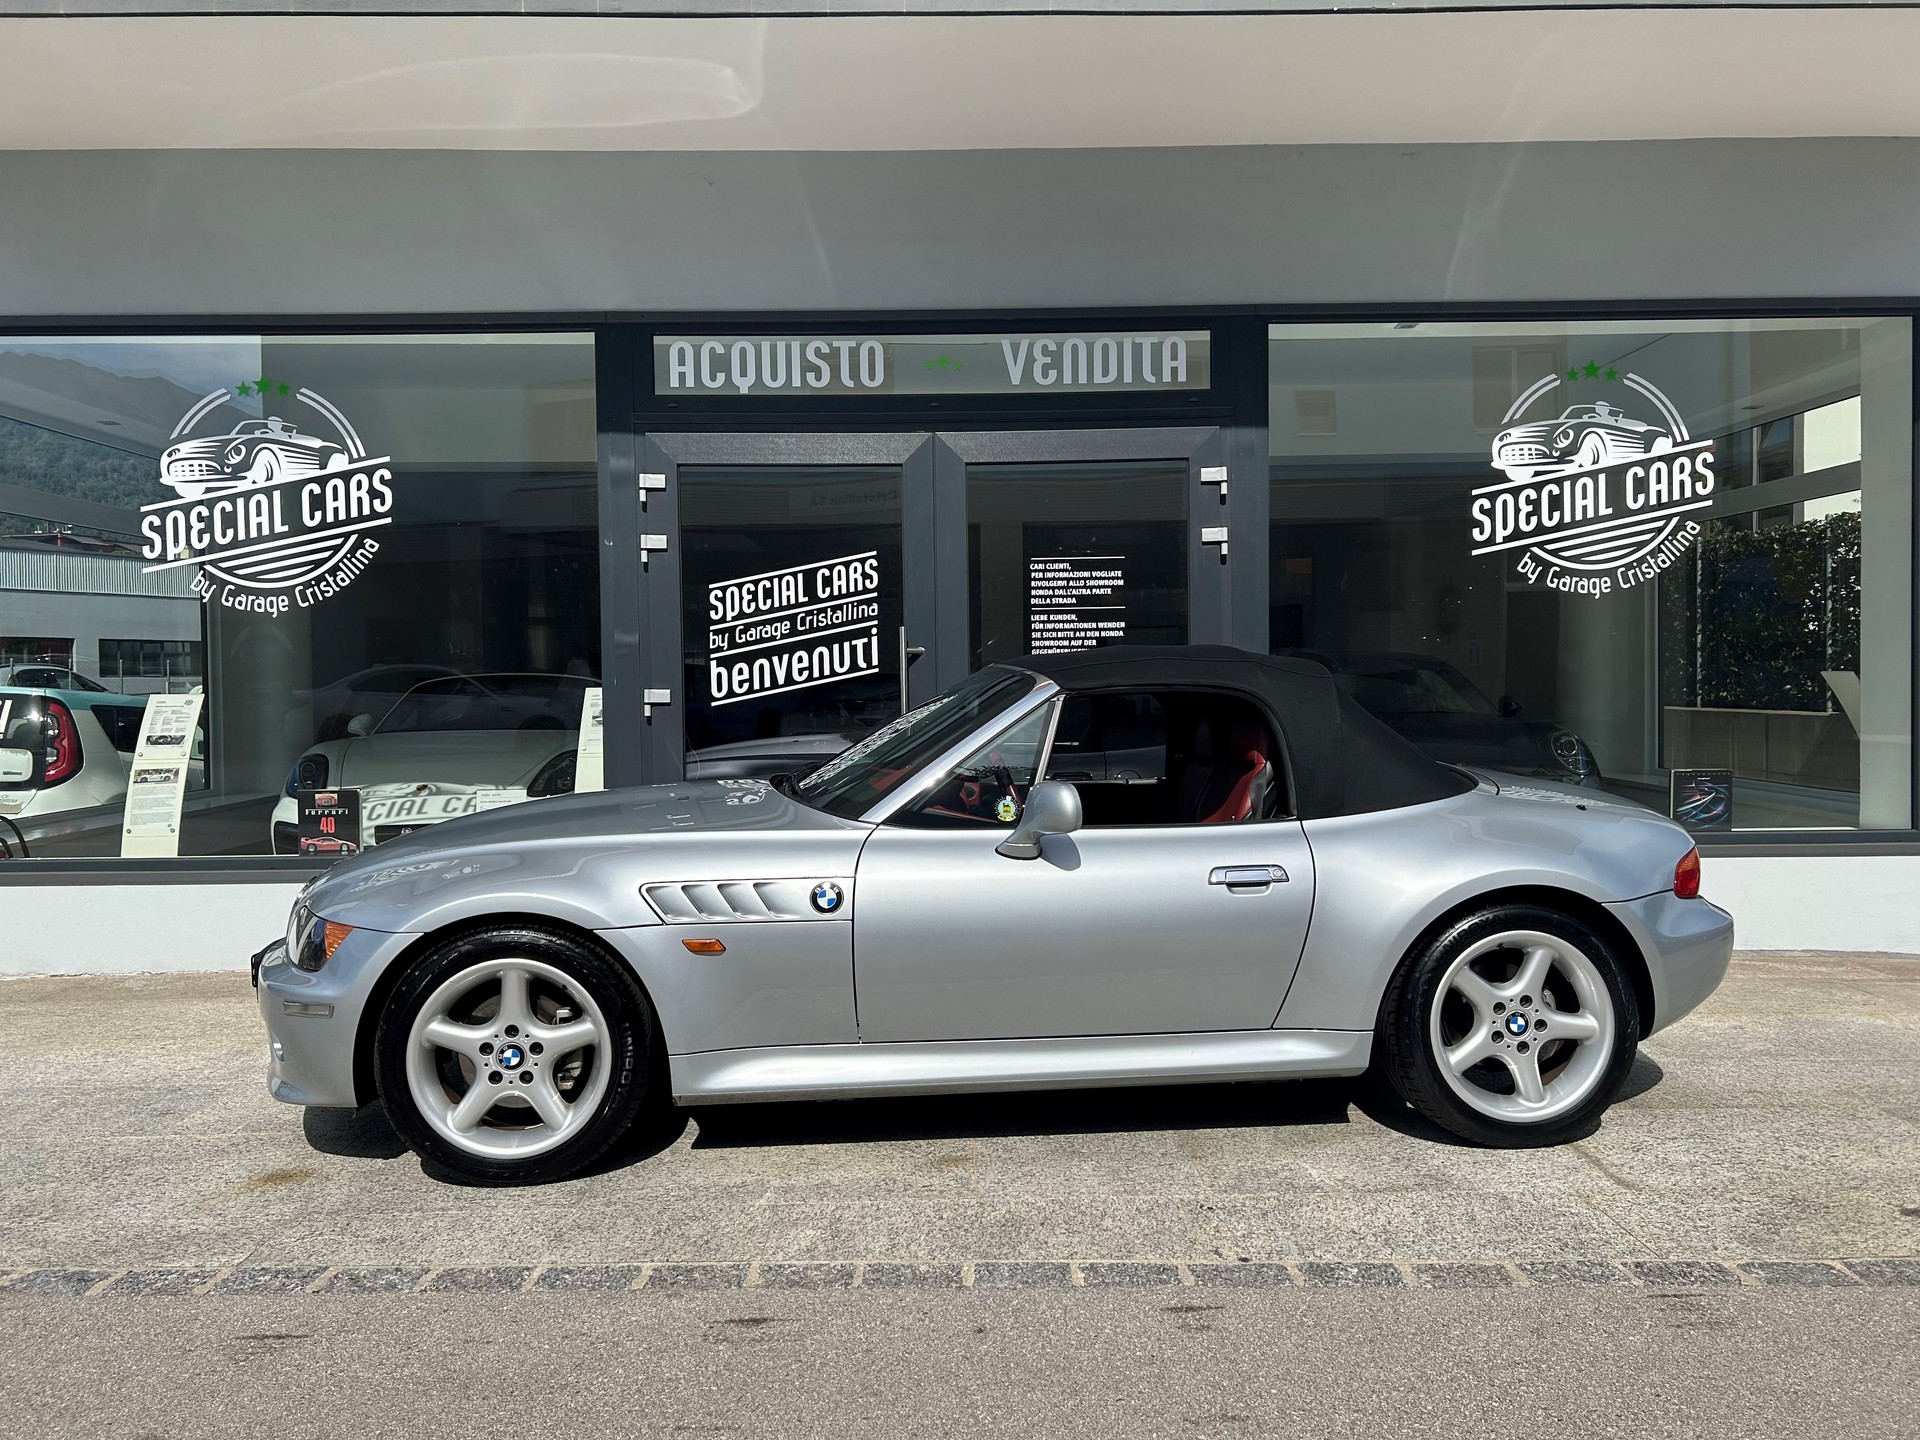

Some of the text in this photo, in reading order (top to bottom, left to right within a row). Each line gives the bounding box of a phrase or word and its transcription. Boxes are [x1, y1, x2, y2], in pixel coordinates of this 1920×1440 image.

[669, 340, 885, 394] ACQUISTO
[1001, 336, 1187, 386] VENDITA
[141, 468, 393, 561] SPECIAL CARS
[1471, 451, 1715, 544] SPECIAL CARS
[190, 537, 380, 618] by Garage Cristallina
[1031, 571, 1043, 579] PER
[1091, 570, 1122, 578] VOGLIATE
[1516, 520, 1701, 600] by Garage Cristallina
[709, 558, 879, 622] SPECIAL CARS
[709, 602, 879, 651] by Garage Cristallina
[1031, 622, 1044, 630] FÜR
[710, 627, 879, 698] benvenuti
[320, 816, 335, 834] 40
